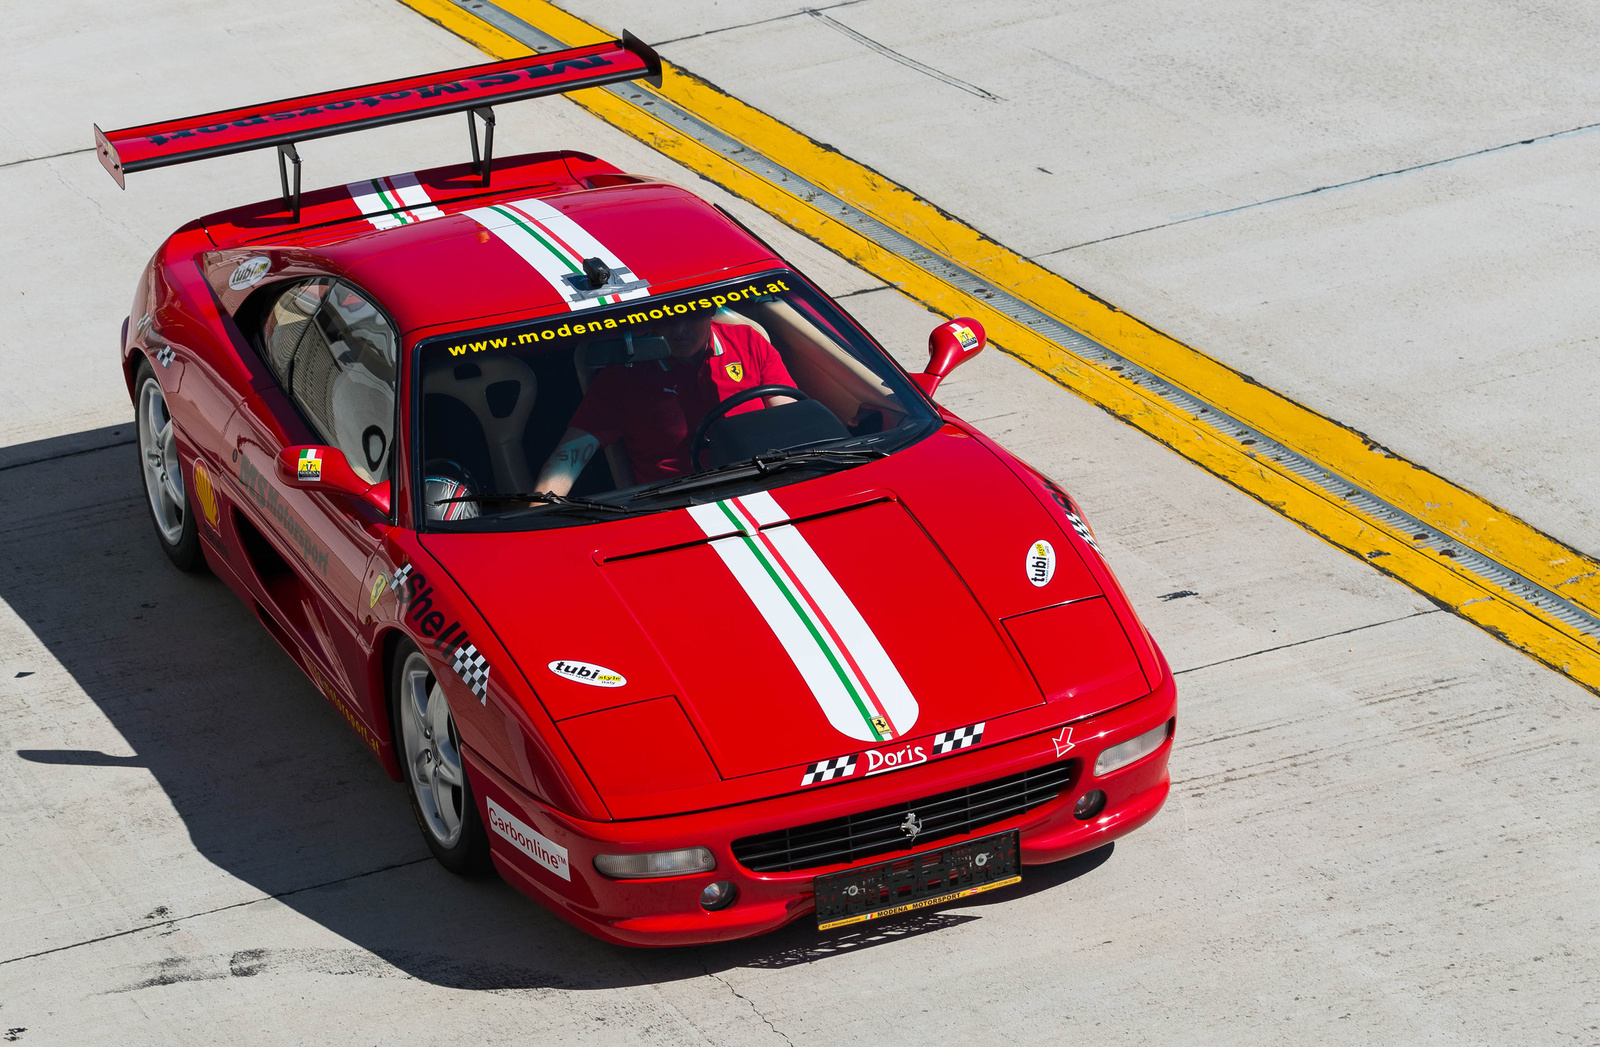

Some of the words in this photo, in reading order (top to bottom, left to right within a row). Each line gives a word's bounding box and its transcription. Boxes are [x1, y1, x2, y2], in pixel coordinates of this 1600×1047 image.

[463, 52, 615, 88] MS
[148, 79, 469, 147] Motorsport
[232, 263, 258, 283] tubi
[447, 278, 791, 357] www.modena-motorsport.at
[266, 487, 329, 578] Motorsport
[1031, 556, 1047, 582] tubi
[397, 572, 469, 660] Shell
[555, 661, 600, 679] tubi
[864, 744, 928, 775] Doris
[877, 906, 909, 917] MODENA
[912, 892, 961, 910] MOTORSPORT
